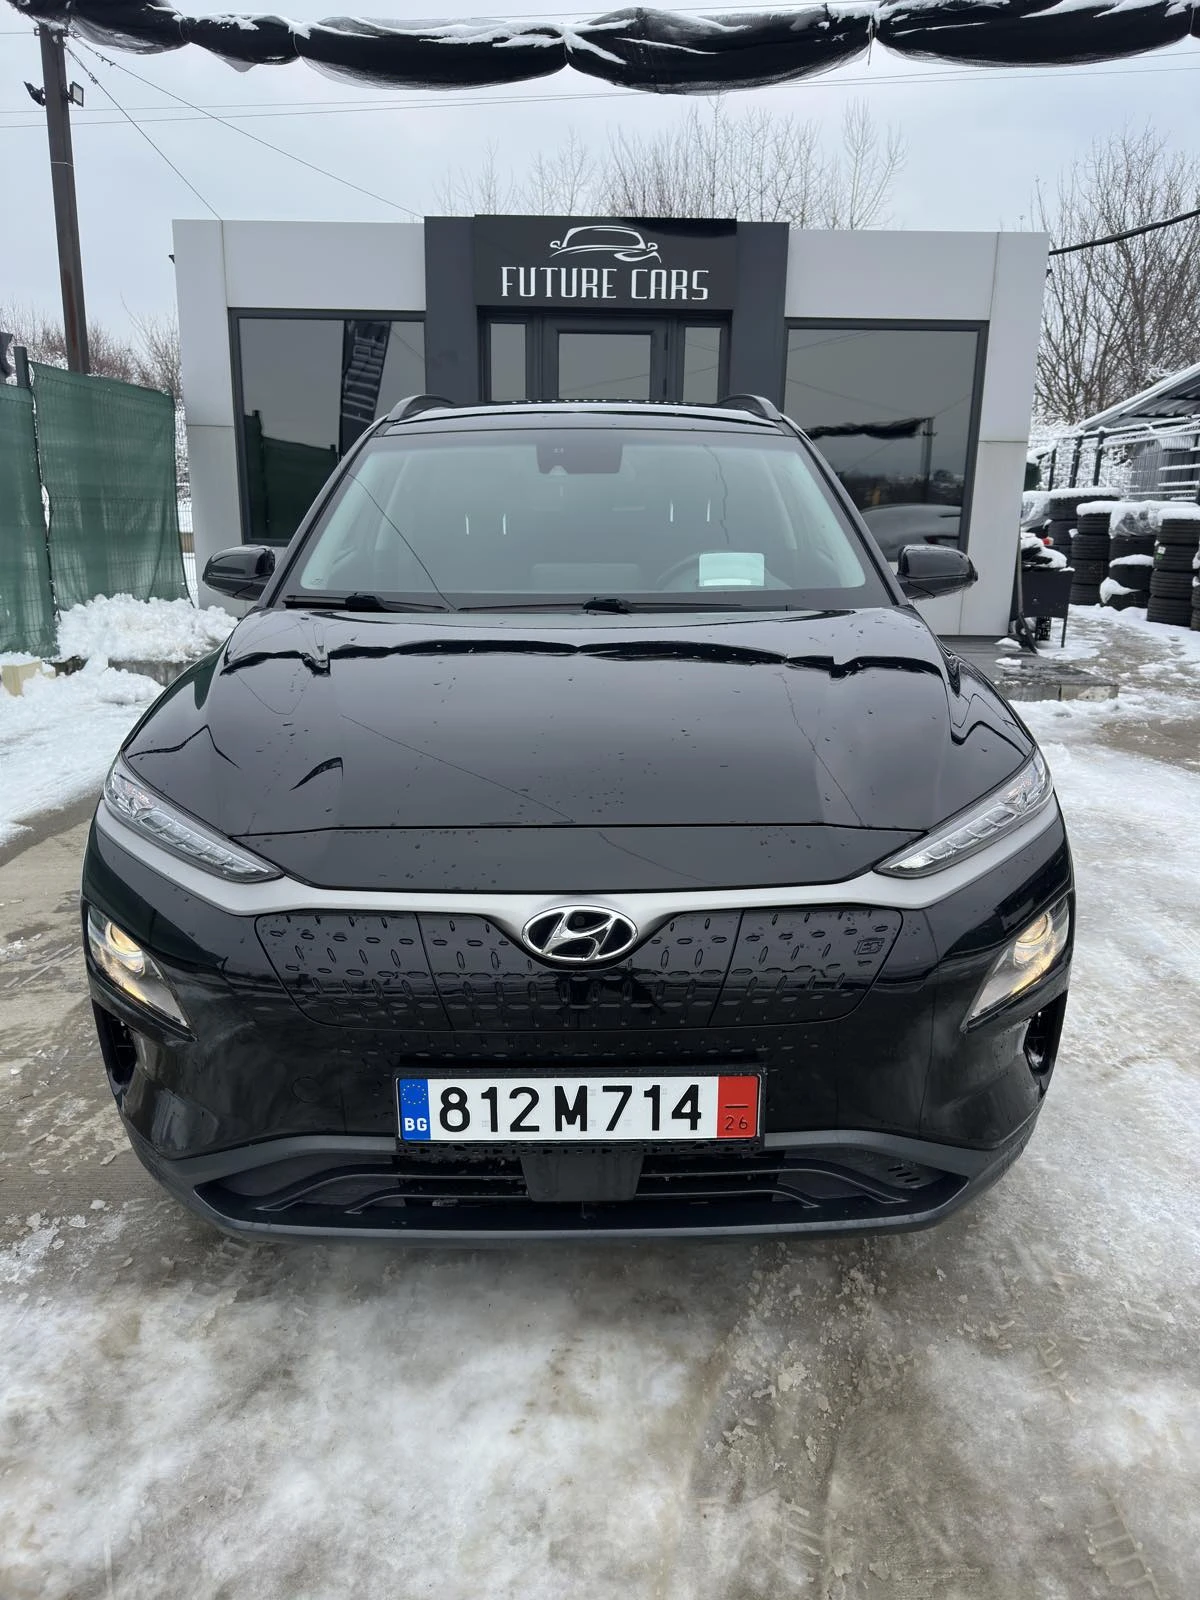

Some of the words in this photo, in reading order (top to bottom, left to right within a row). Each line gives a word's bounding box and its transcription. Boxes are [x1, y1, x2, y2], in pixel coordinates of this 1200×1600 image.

[501, 266, 617, 298] FUTURE
[631, 268, 708, 300] CARS
[404, 1117, 427, 1132] BG
[724, 1116, 748, 1130] 26
